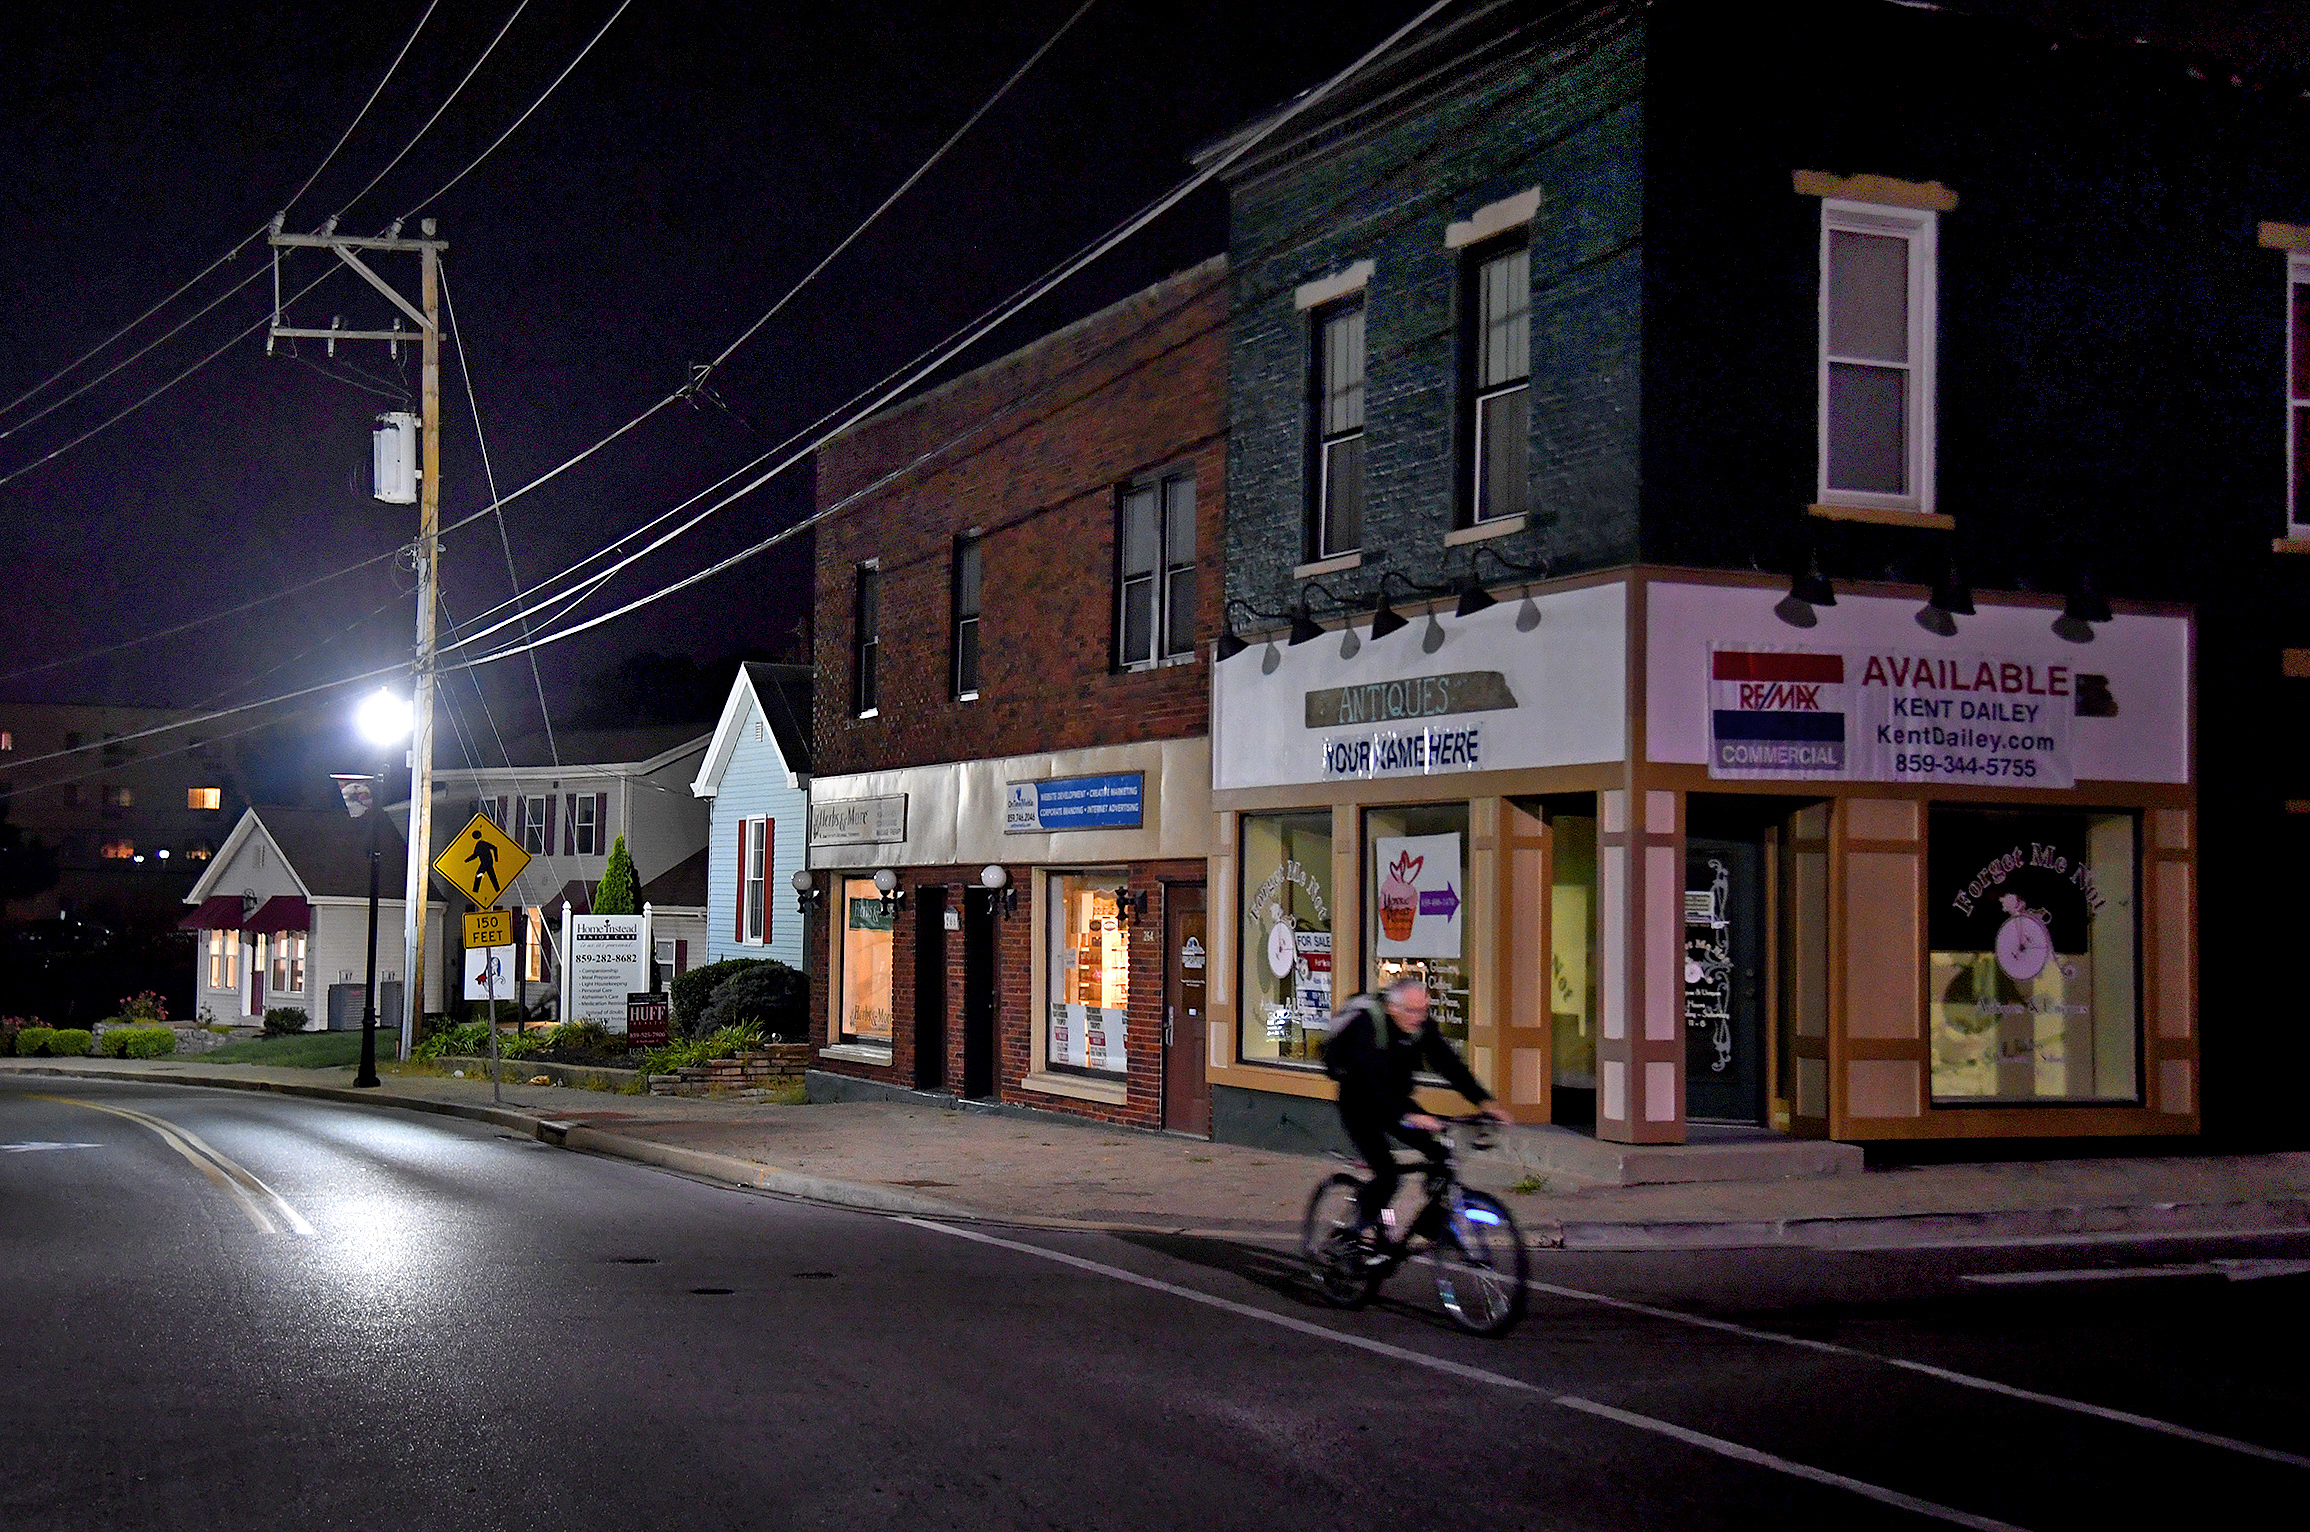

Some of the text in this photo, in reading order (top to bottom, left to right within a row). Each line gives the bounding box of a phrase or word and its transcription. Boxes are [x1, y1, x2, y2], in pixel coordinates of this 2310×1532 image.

[1862, 655, 2070, 697] AVAILABLE
[1338, 677, 1450, 724] ANTIQUES
[1739, 682, 1821, 711] RE/MAX
[1893, 697, 2040, 723] KENT DAILEY
[1876, 724, 2055, 753] KentDailey.com
[1325, 730, 1479, 774] YOUR NAME HERE
[1721, 744, 1838, 767] COMMERCIAL
[1894, 753, 2038, 778] 859-344-5755
[1057, 789, 1087, 801] DEVELOPMENT
[1110, 785, 1139, 797] MARKETING
[846, 805, 869, 826] More
[1039, 807, 1063, 817] CORPORATE
[1086, 804, 1109, 814] INTERNET
[1108, 802, 1139, 813] ADVERTISING
[1286, 859, 1307, 888] Me
[1952, 842, 2107, 918] Forget Me Not
[476, 916, 499, 929] 150
[576, 922, 638, 934] Home Instead
[472, 930, 503, 944] FEET
[1296, 935, 1332, 948] FOR SALE
[575, 953, 637, 963] 859-282-8682
[630, 1006, 667, 1021] HUFF
